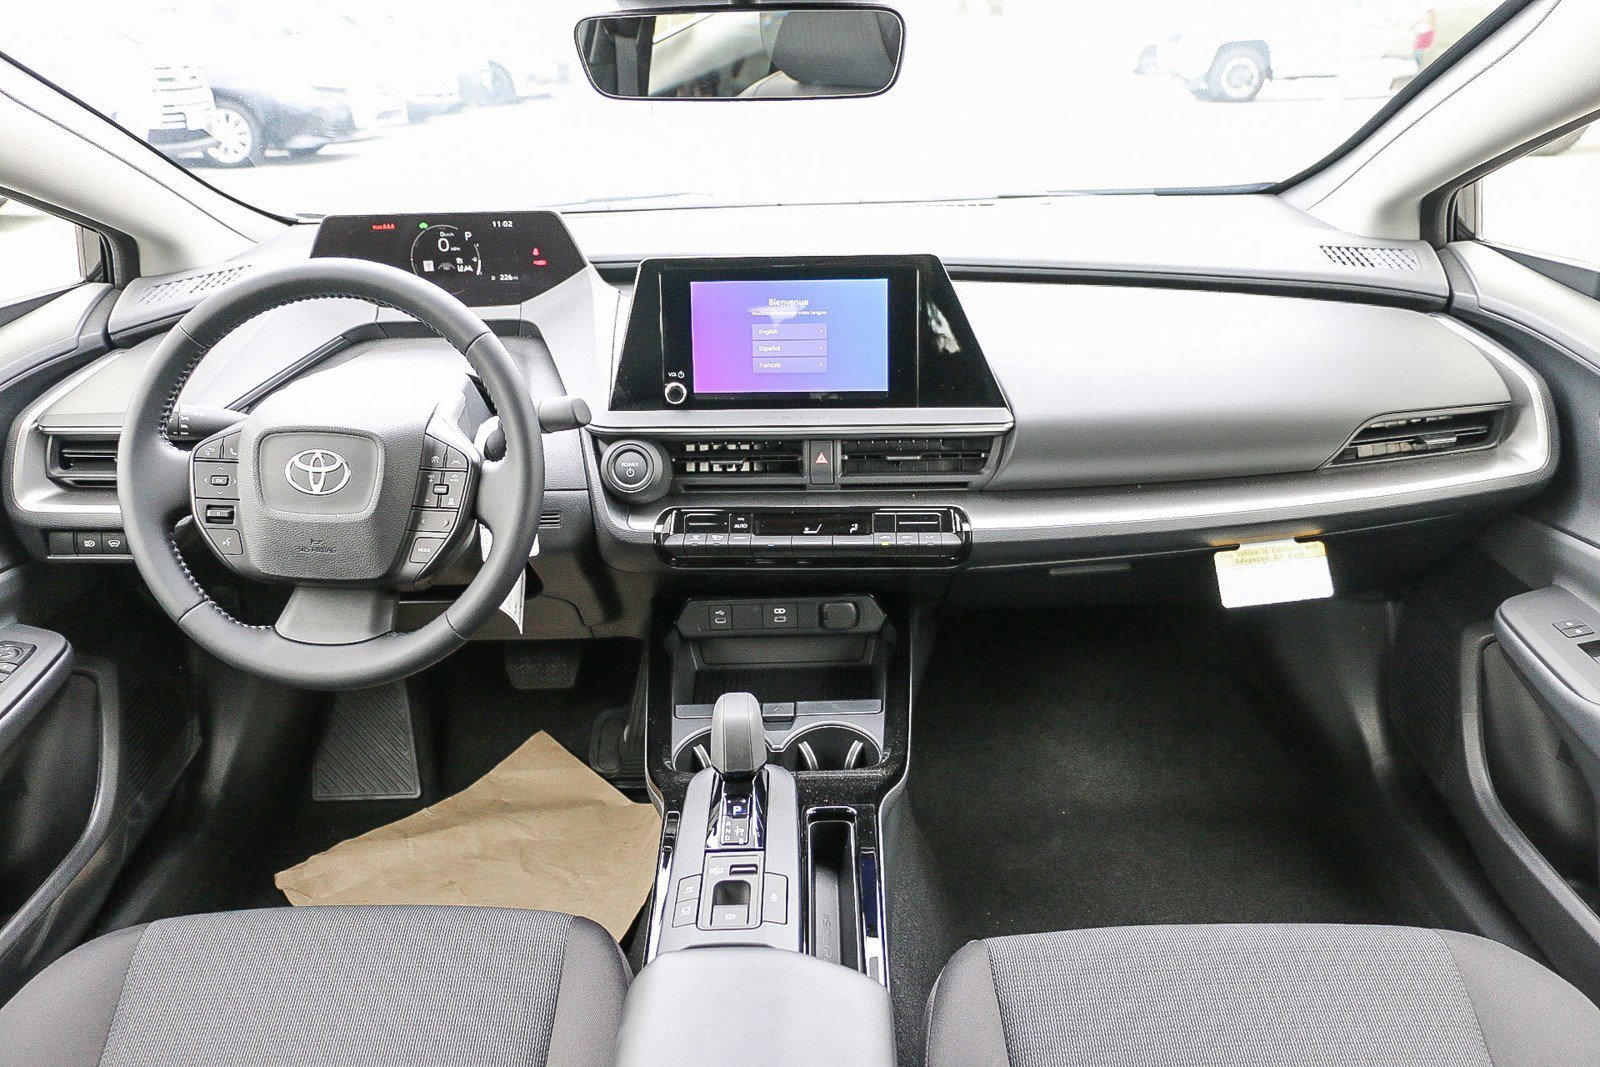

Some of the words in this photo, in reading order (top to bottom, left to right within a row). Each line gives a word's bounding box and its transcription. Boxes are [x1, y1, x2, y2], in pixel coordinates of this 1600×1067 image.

[491, 220, 513, 228] 11:02
[464, 231, 472, 241] P
[437, 237, 450, 252] 0
[768, 298, 809, 307] Bienvenue
[733, 805, 742, 816] P
